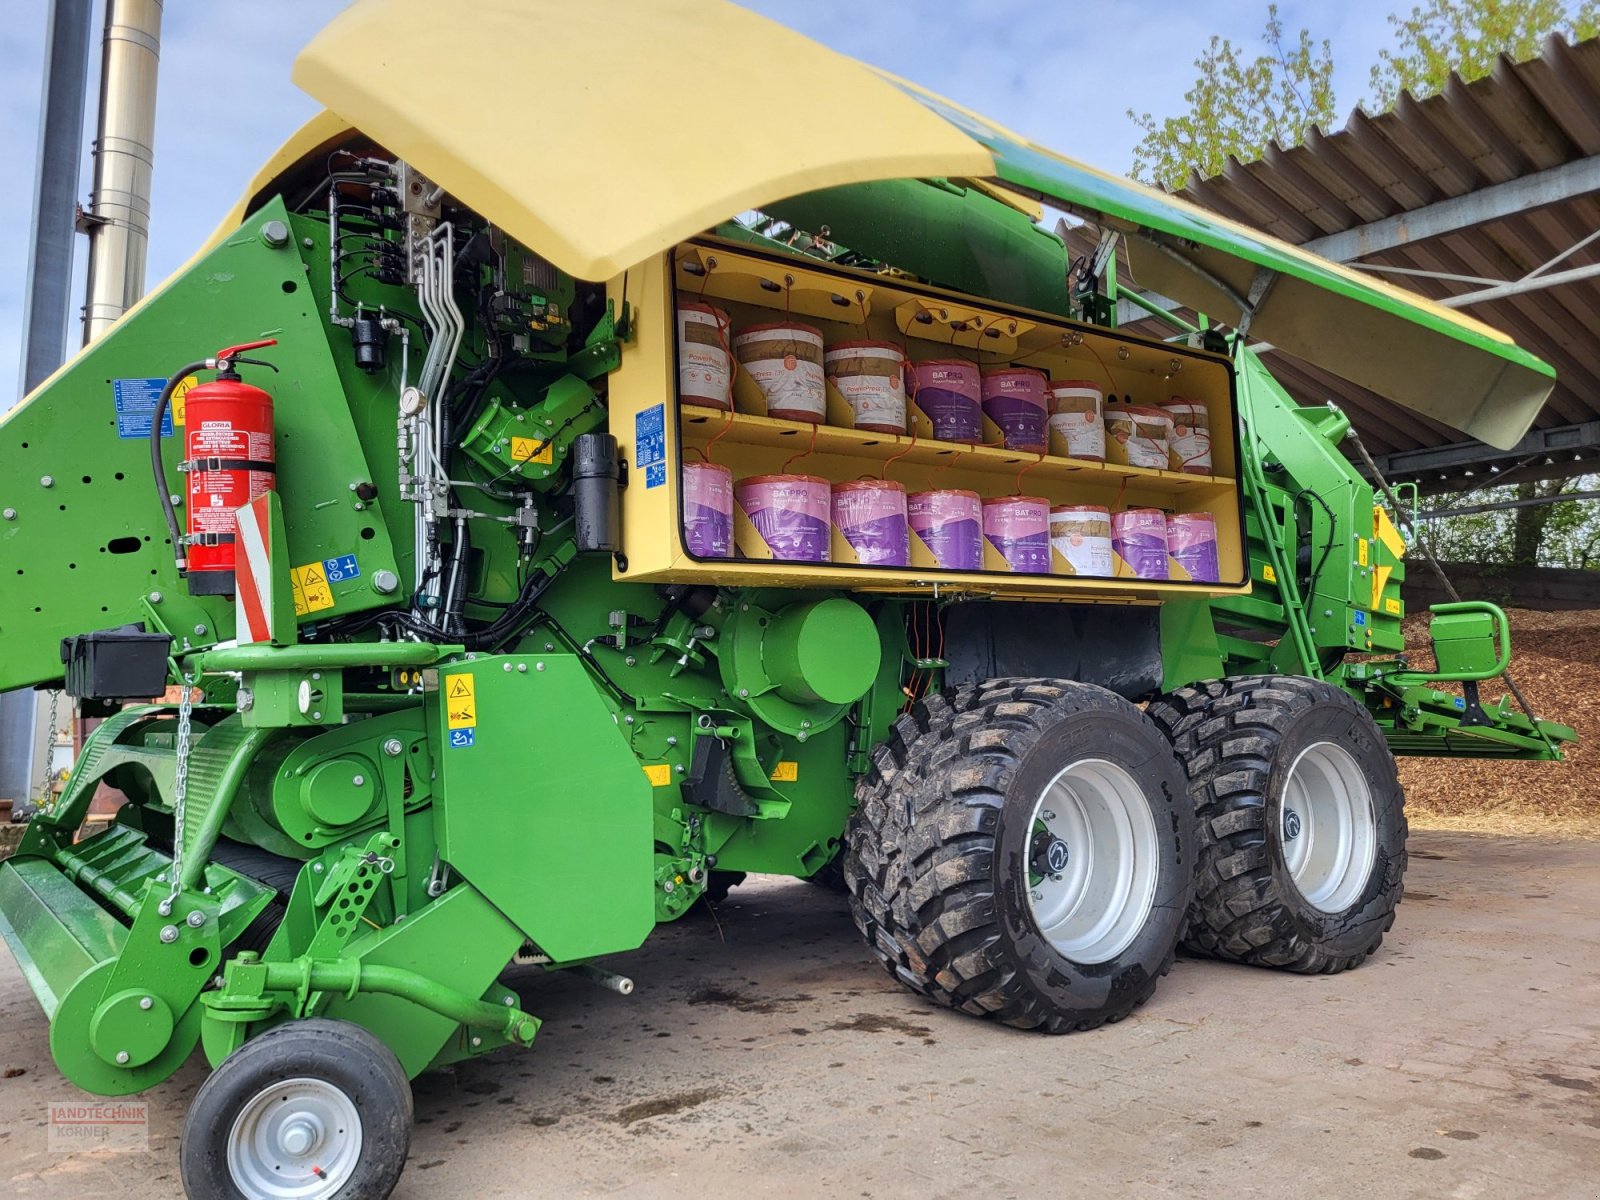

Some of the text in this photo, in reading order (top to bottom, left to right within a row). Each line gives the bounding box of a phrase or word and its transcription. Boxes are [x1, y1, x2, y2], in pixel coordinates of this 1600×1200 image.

[932, 371, 963, 379] BATPRO
[1001, 380, 1031, 388] BATPRO
[773, 489, 808, 498] BATPRO
[1015, 509, 1042, 517] BATPRO
